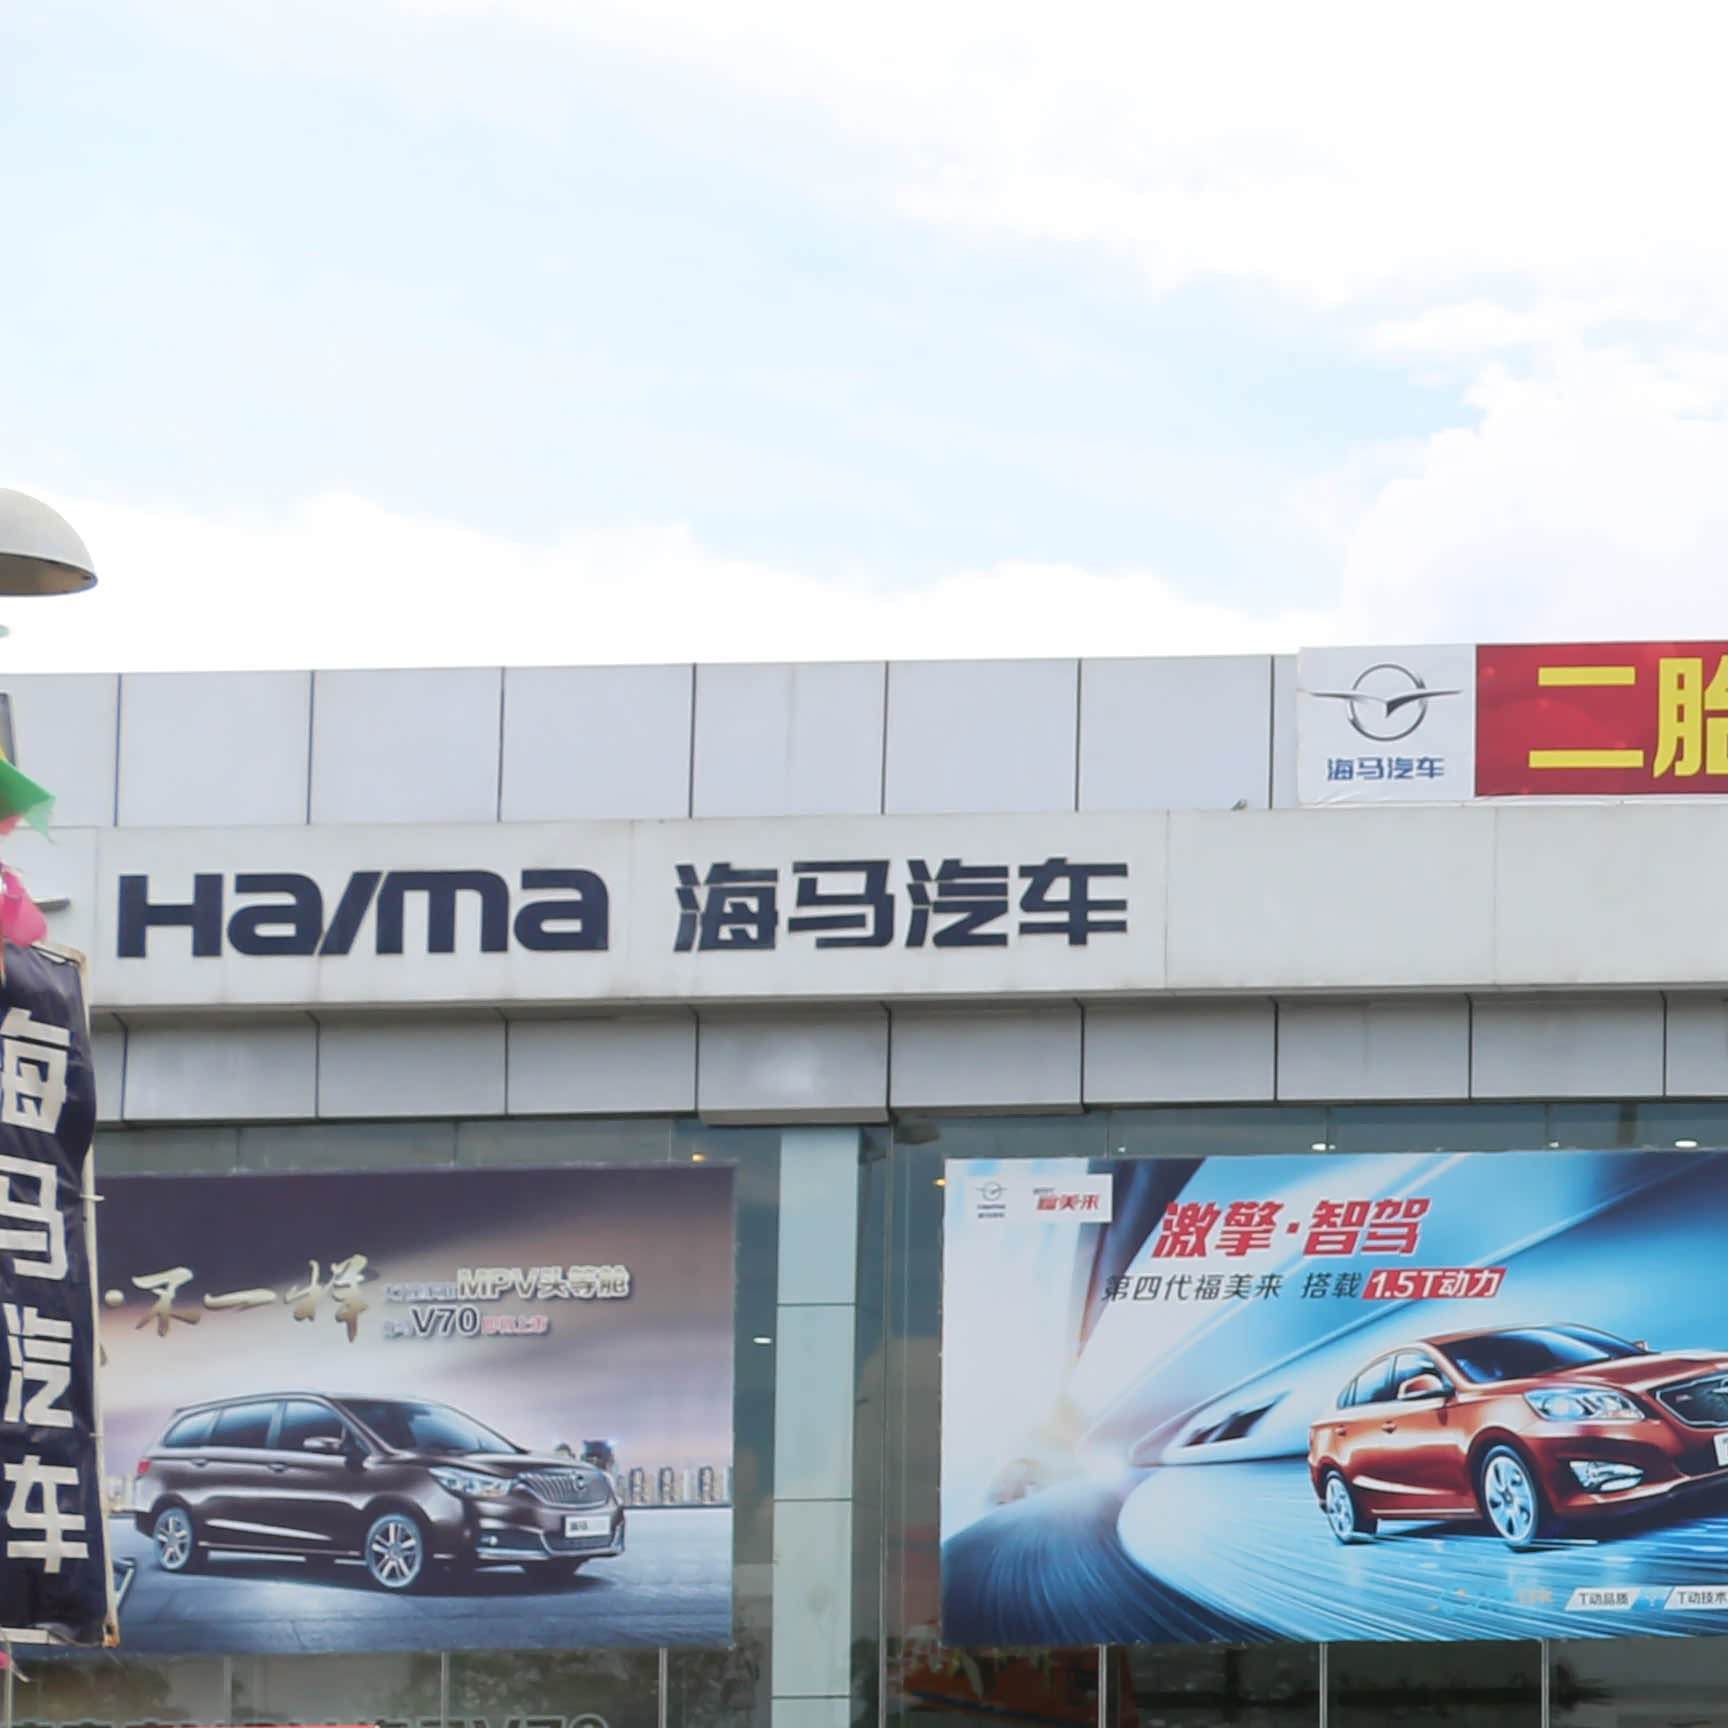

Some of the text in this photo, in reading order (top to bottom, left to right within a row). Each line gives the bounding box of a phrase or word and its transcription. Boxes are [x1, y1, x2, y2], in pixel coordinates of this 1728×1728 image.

[1326, 756, 1445, 782] 海马汽车
[672, 858, 1129, 953] 海马汽车
[1152, 1198, 1431, 1259] 激擎·智驾
[0, 1008, 90, 1574] 海马汽车
[1104, 1273, 1285, 1302] 第四代福美来
